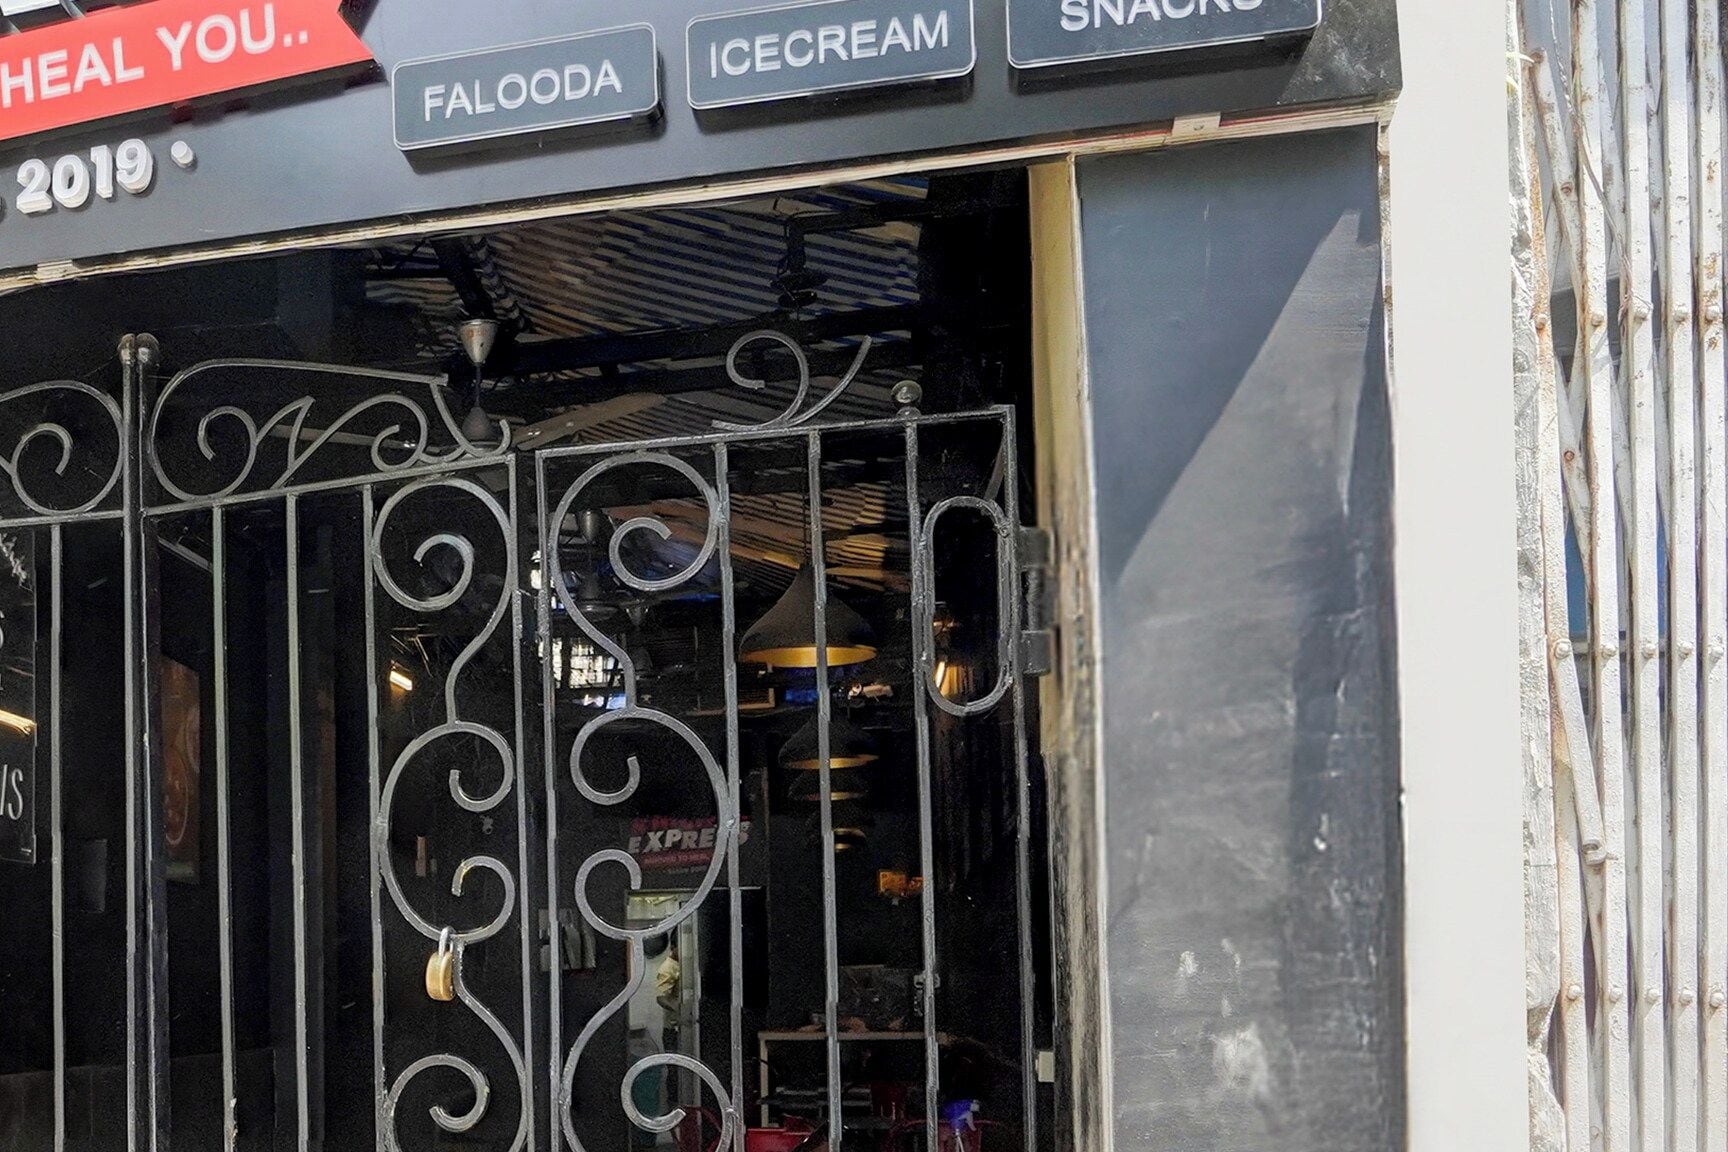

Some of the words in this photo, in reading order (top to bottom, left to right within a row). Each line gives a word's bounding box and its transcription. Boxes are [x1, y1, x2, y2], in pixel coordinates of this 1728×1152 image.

[709, 9, 949, 79] ICECREAM
[1059, 0, 1264, 32] SNAC
[0, 36, 145, 109] HEAL
[155, 3, 309, 72] YOU..
[423, 59, 623, 122] FALOODA
[15, 137, 154, 214] 2019
[627, 821, 751, 854] EXPRE
